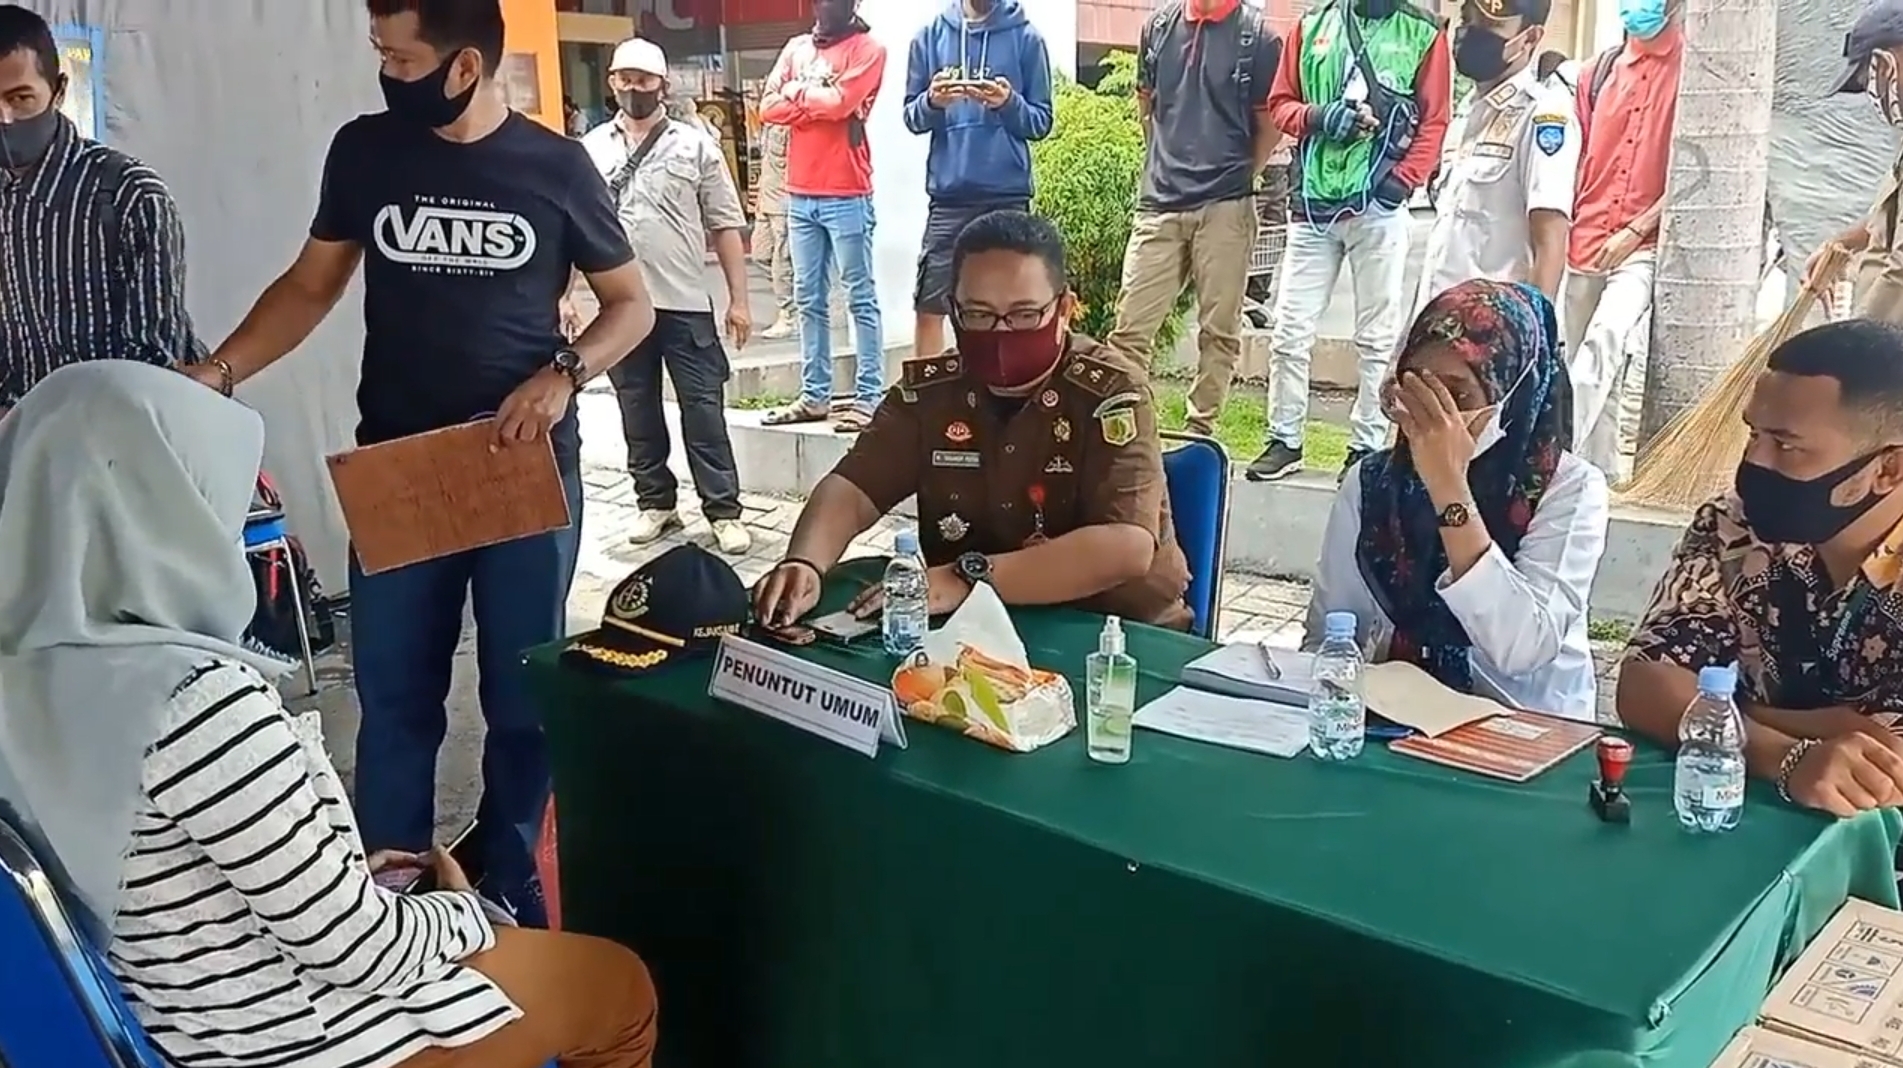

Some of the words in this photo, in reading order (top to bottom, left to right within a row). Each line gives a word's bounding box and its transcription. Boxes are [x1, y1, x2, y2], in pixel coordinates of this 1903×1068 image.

[413, 194, 435, 204] THE
[441, 197, 496, 209] ORIGINAL
[387, 204, 516, 258] VANS
[722, 655, 817, 705] PENUNTUT
[821, 689, 880, 729] UMUM
